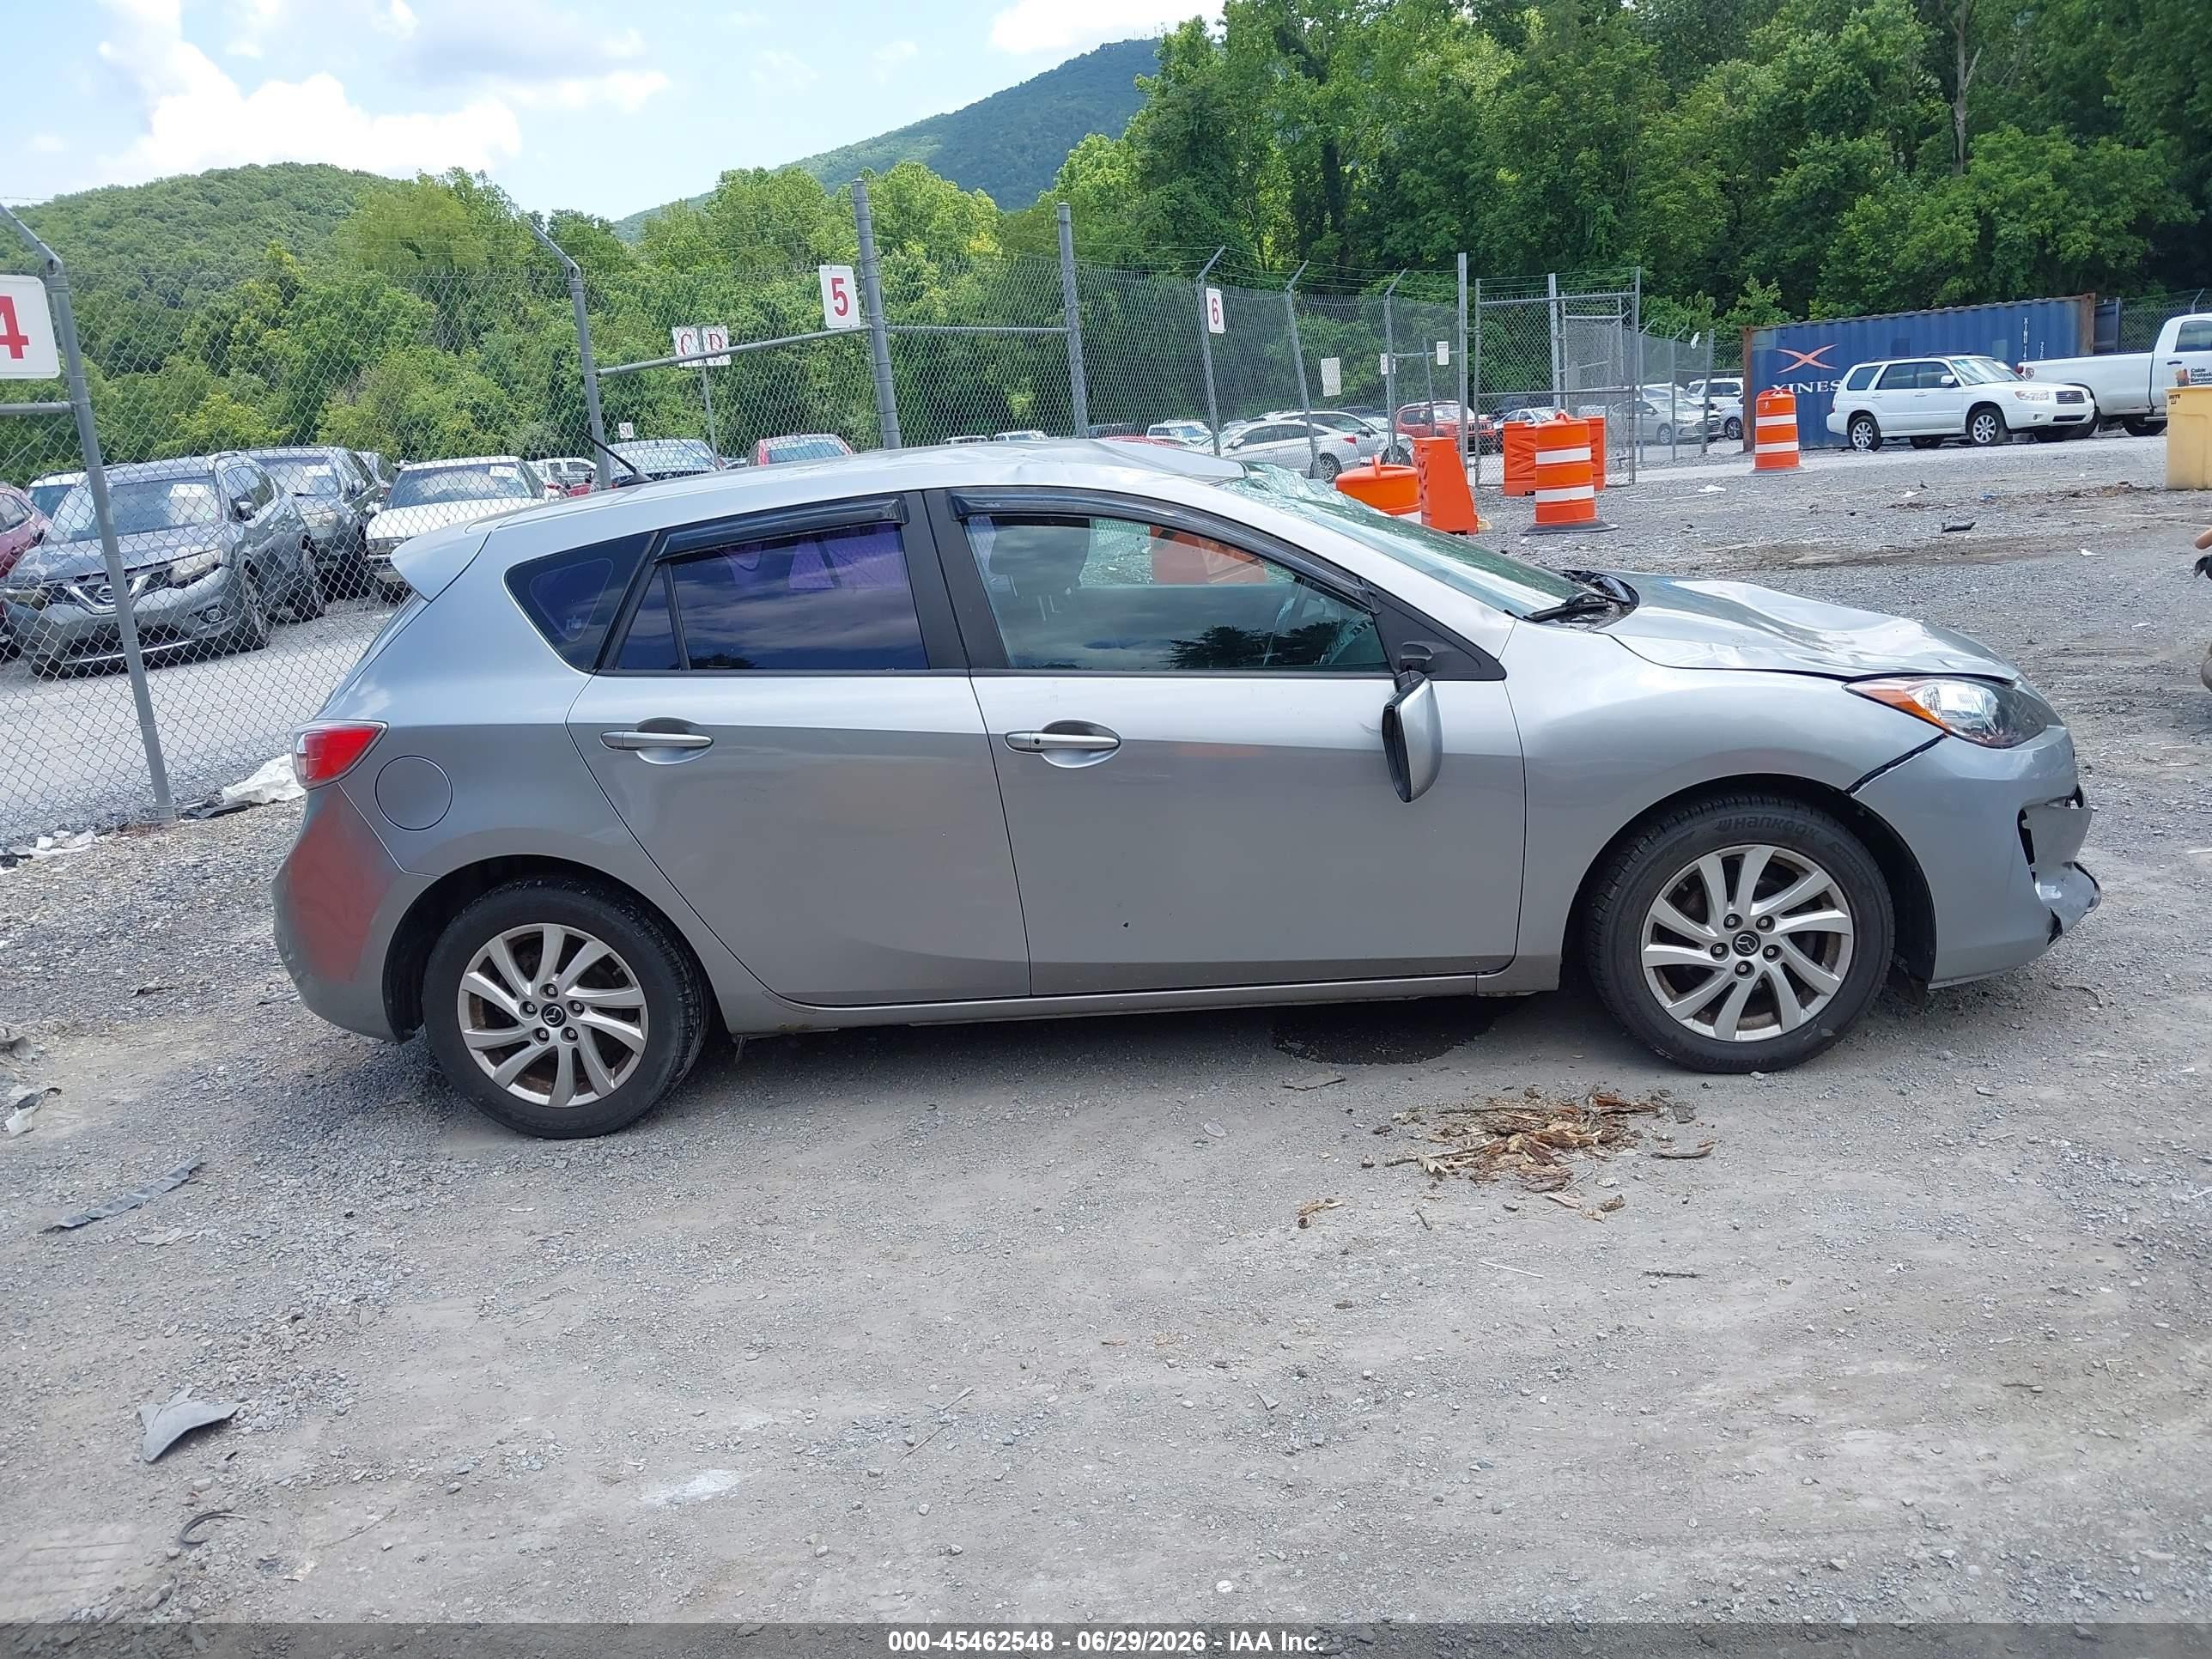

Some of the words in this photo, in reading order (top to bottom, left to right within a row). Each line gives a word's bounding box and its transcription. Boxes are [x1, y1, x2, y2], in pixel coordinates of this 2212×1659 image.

[830, 277, 849, 317] 5
[1212, 297, 1219, 325] 6
[0, 295, 29, 359] 4
